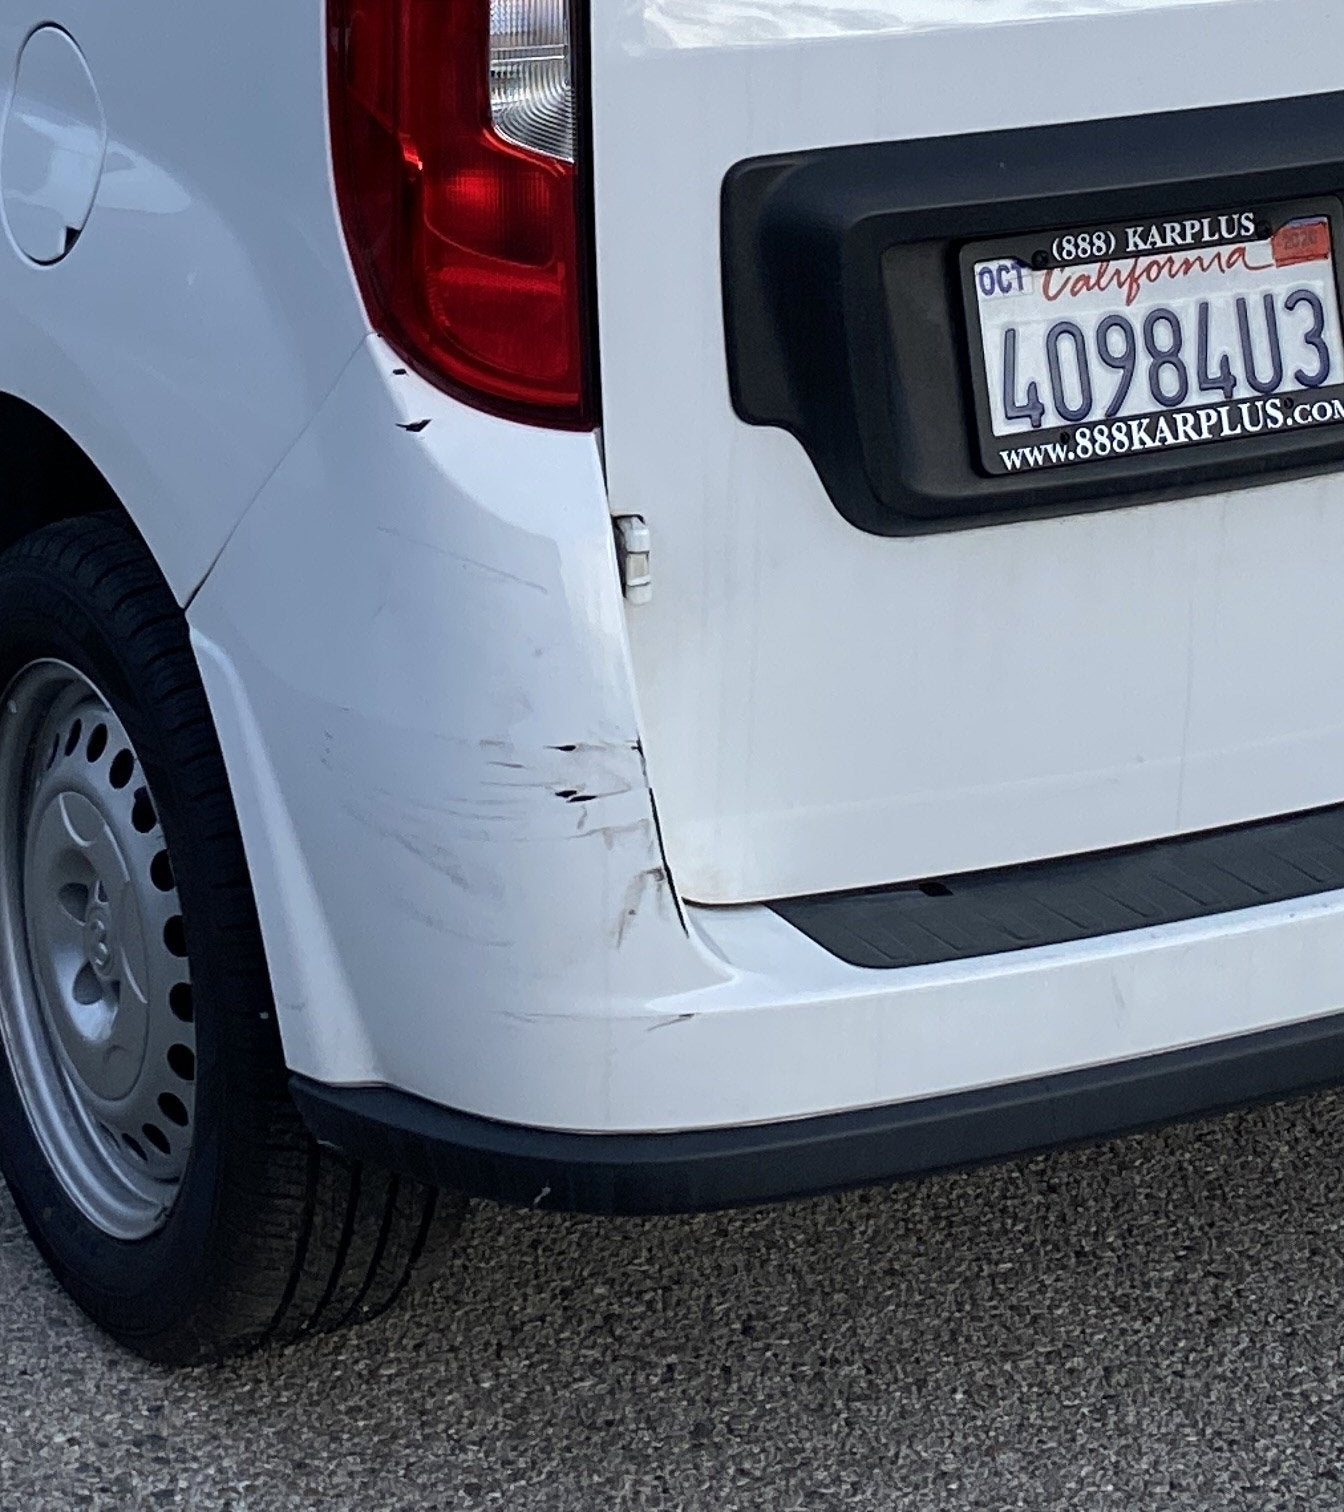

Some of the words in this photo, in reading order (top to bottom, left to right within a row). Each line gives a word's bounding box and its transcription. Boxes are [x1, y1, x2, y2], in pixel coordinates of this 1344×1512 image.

[1051, 228, 1117, 262] (888)
[1124, 212, 1256, 253] KARPLUS
[977, 258, 1025, 297] OCT
[1041, 245, 1275, 307] California
[1002, 288, 1332, 429] 40984U3
